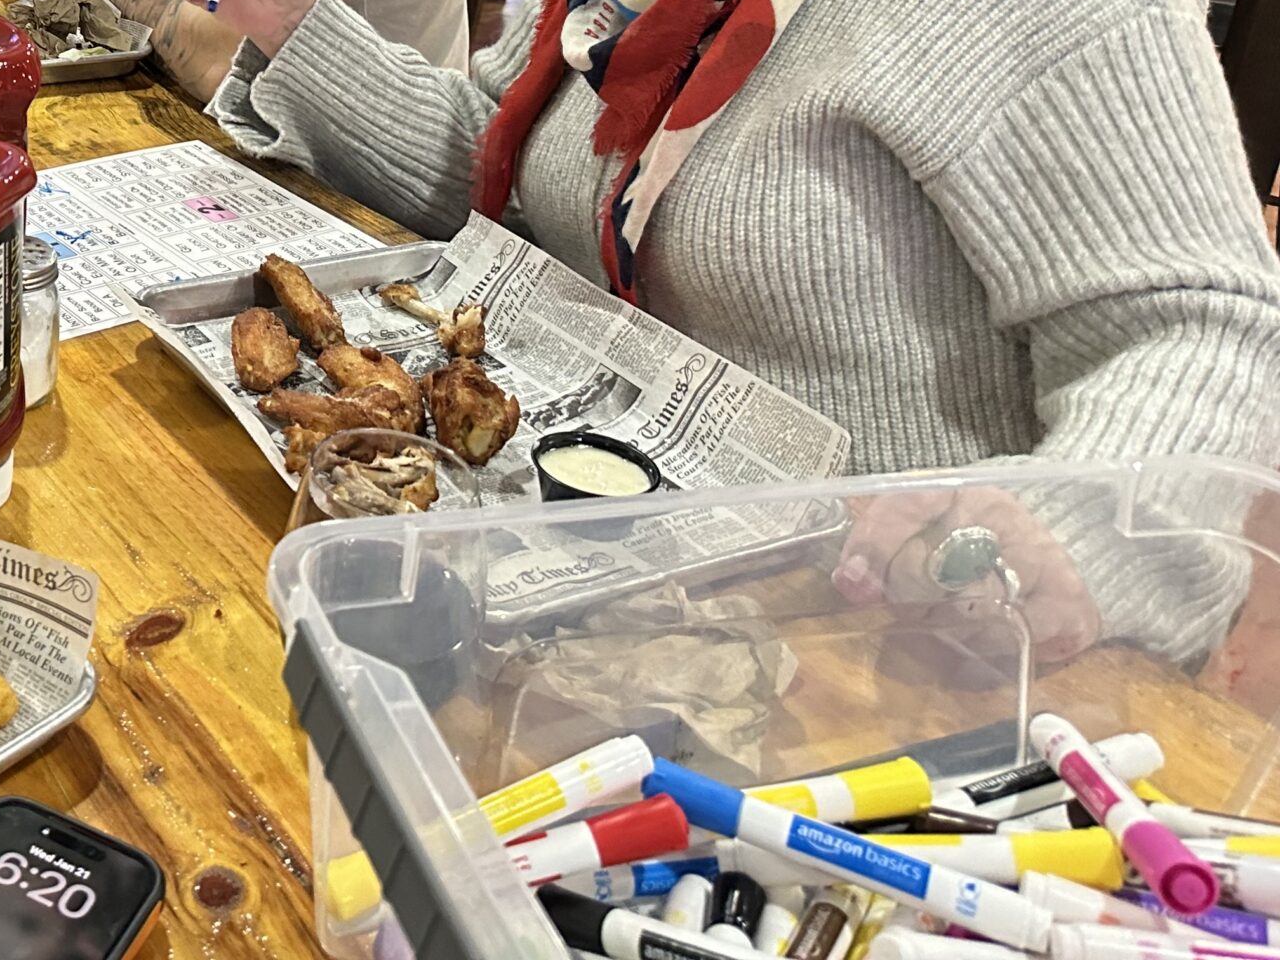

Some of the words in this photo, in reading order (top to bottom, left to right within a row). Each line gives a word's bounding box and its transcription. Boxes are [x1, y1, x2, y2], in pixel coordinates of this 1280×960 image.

[637, 378, 689, 440] Times
[6, 624, 27, 641] Par
[24, 617, 41, 632] Of
[13, 645, 40, 667] Local
[41, 659, 74, 685] Events
[29, 844, 55, 864] Wed
[54, 858, 76, 874] Jan
[75, 866, 91, 880] 21
[796, 823, 864, 859] amazon
[865, 846, 922, 881] basics
